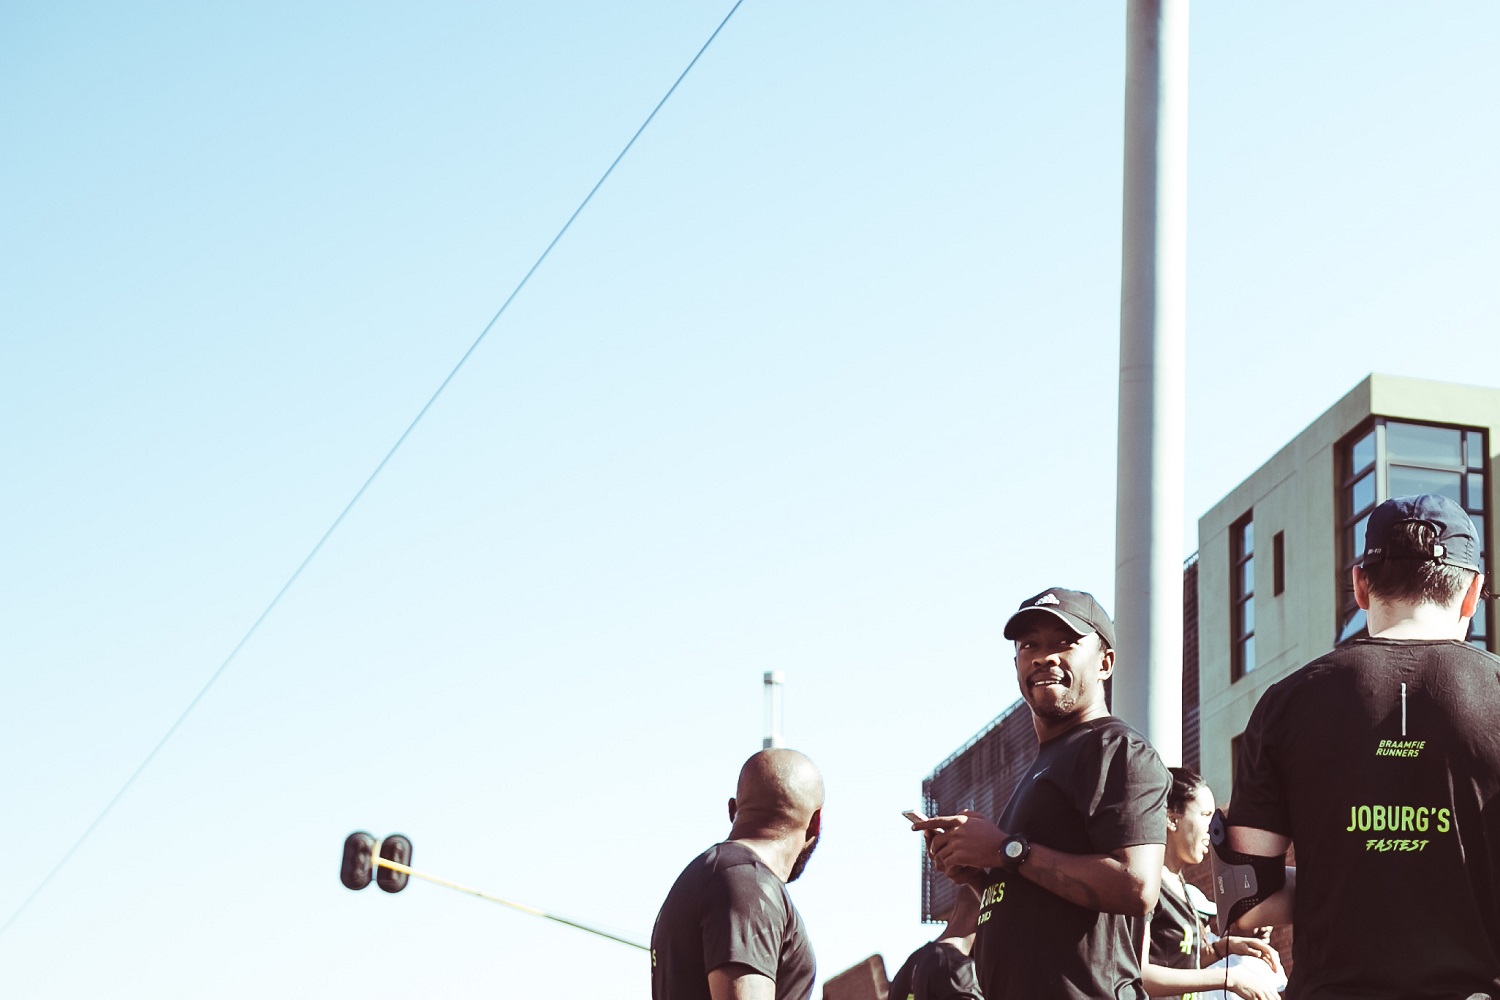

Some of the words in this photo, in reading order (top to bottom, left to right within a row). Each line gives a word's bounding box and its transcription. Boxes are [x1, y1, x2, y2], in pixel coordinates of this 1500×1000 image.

[1376, 748, 1419, 757] RUNNERS
[1346, 805, 1450, 833] JOBURG'S
[1365, 838, 1430, 852] FASTEST
